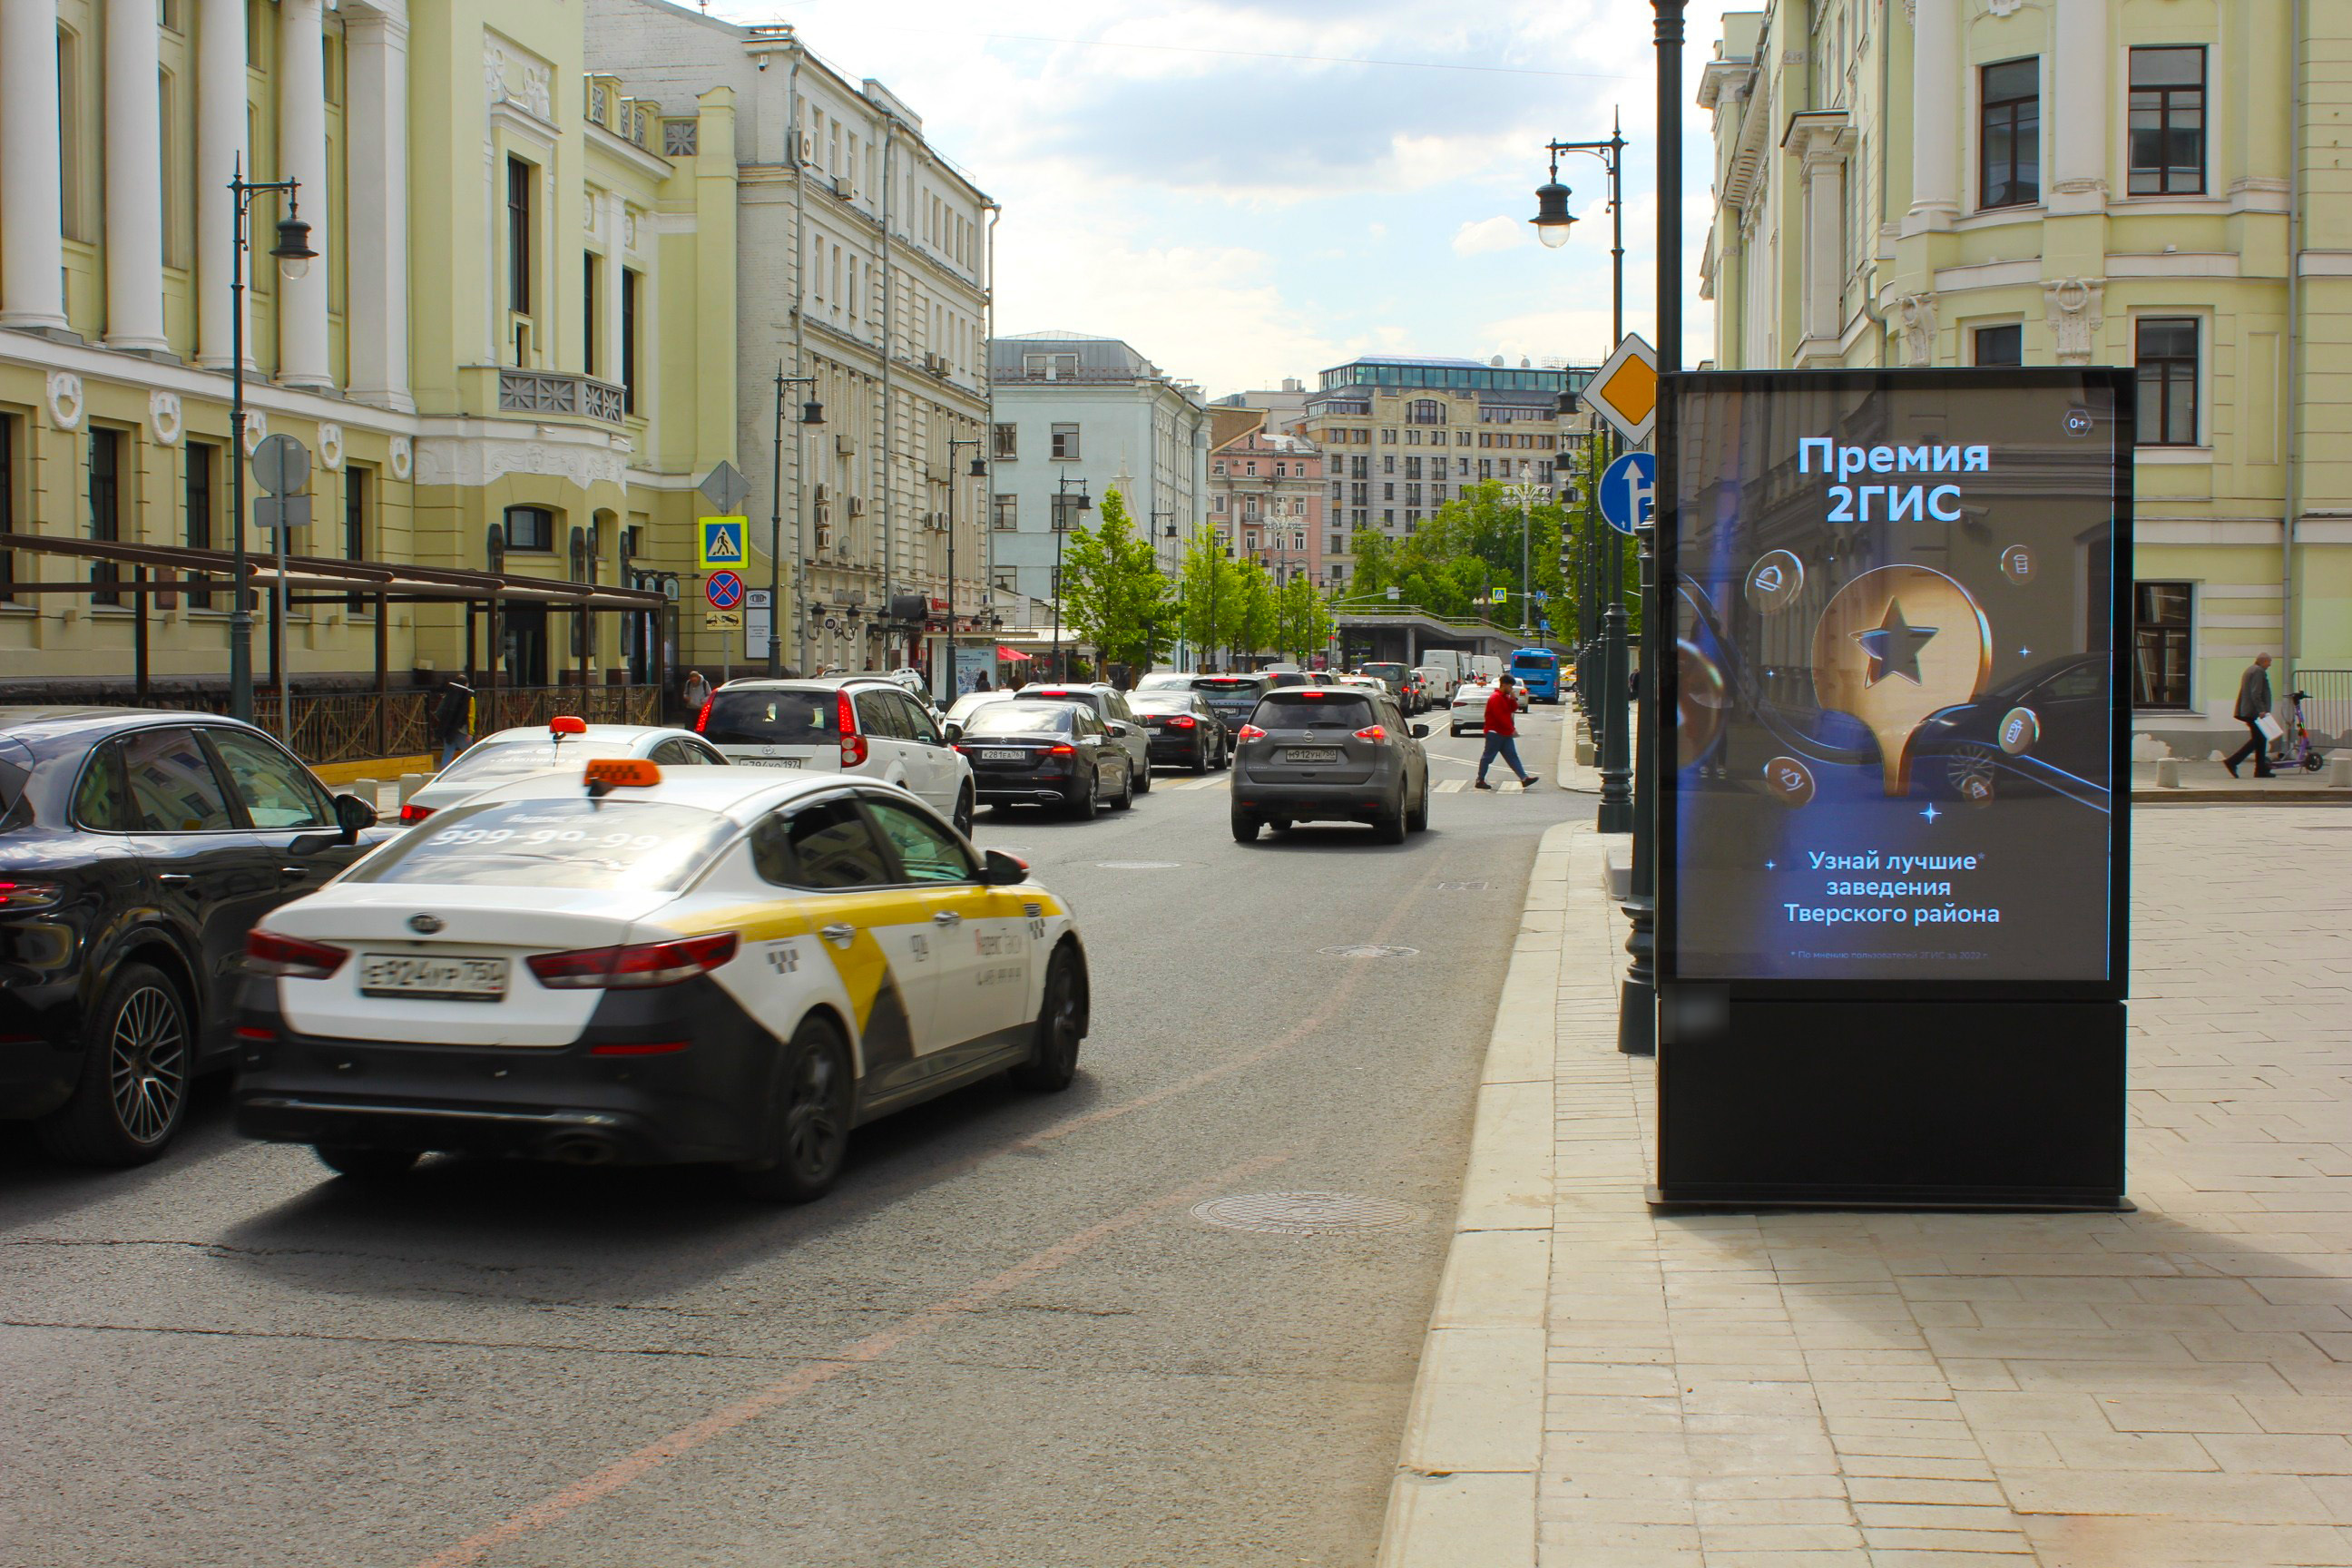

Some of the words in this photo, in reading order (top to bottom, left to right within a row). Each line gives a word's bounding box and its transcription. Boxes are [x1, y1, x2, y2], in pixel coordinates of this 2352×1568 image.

[2069, 417, 2086, 429] 0+
[1798, 436, 1990, 483] Премия
[1827, 484, 1962, 523] 2ГИС
[1808, 849, 1879, 870] Узнай
[1826, 880, 1951, 898] заведения
[1783, 903, 1907, 926] Тверского
[1914, 902, 2000, 926] района
